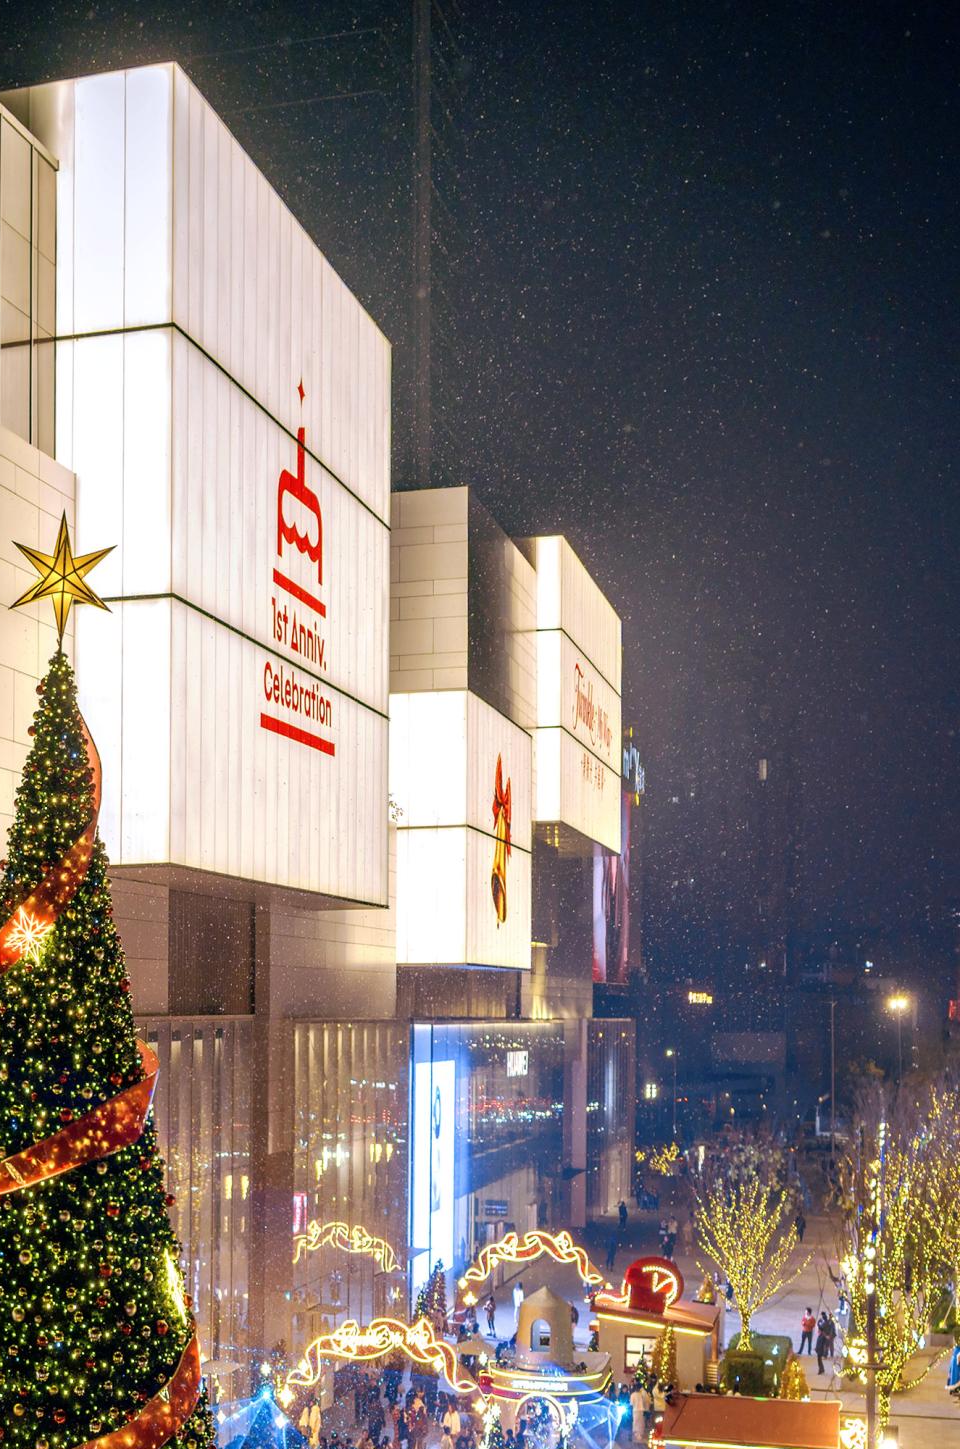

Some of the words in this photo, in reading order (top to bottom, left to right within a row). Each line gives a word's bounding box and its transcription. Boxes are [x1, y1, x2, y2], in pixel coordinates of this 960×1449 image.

[272, 597, 288, 644] 1st
[290, 612, 327, 671] Anniv.
[264, 661, 332, 728] Celebration
